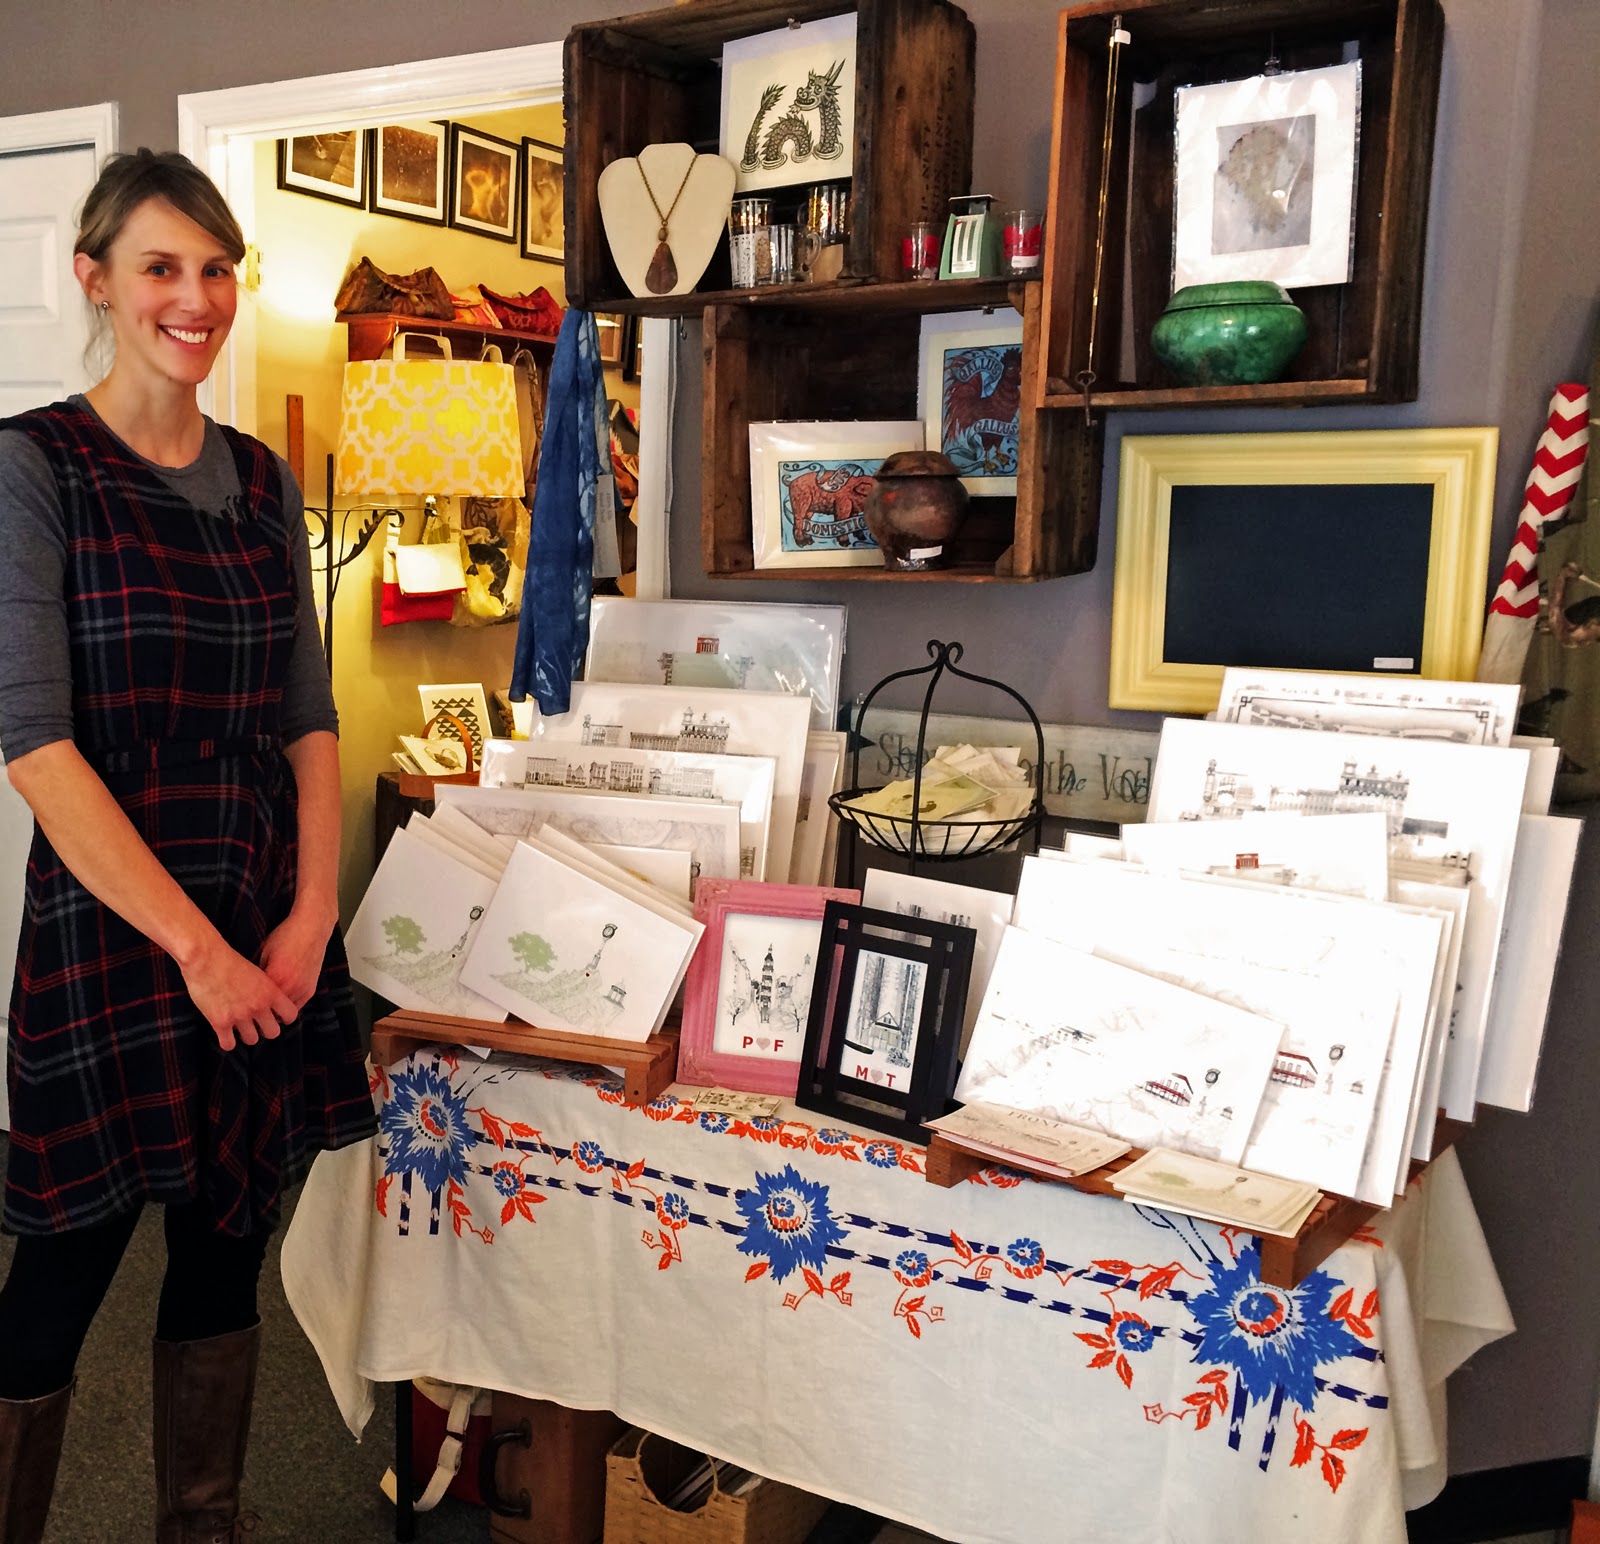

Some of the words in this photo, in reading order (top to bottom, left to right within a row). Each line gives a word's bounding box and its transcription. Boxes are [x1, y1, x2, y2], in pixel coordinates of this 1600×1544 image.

[960, 357, 1000, 381] GALLUS
[973, 420, 1019, 435] GALLUS
[826, 467, 851, 491] SUS
[742, 1036, 753, 1049] P
[773, 1039, 784, 1052] F
[855, 1065, 868, 1080] M
[886, 1073, 896, 1088] T
[1008, 1111, 1063, 1129] FRONT
